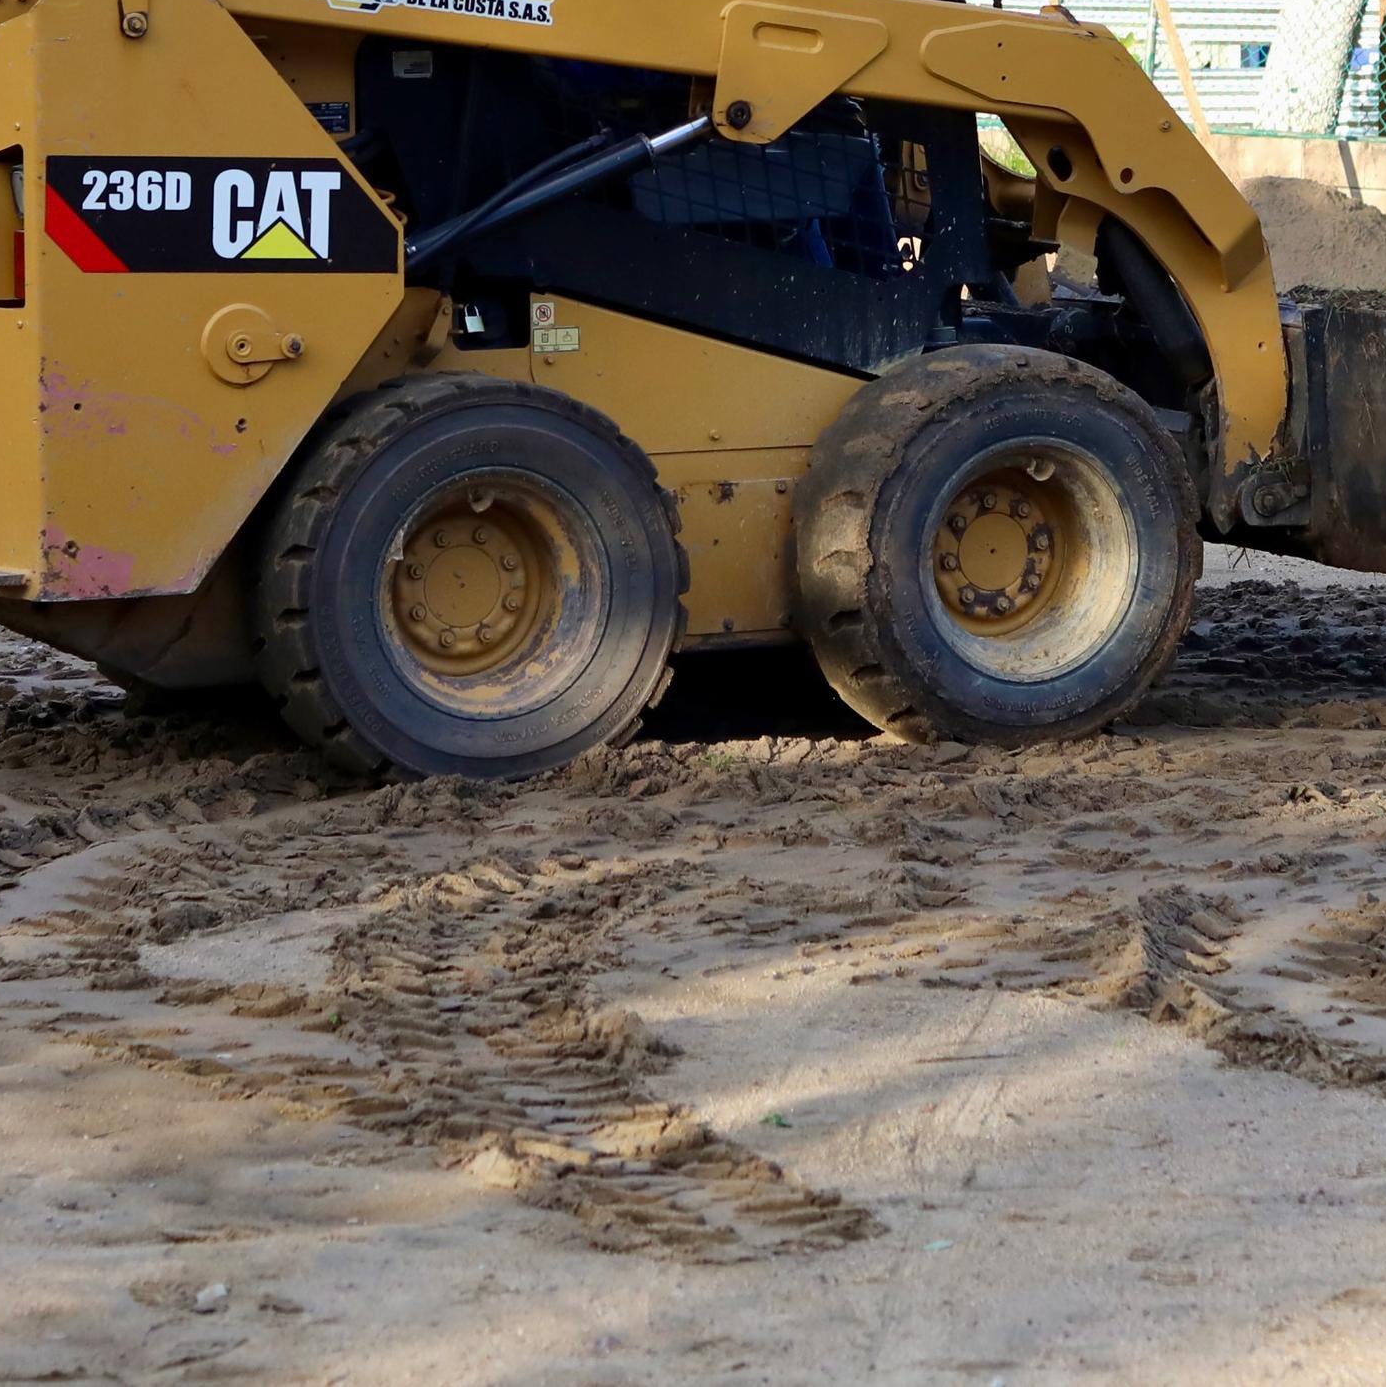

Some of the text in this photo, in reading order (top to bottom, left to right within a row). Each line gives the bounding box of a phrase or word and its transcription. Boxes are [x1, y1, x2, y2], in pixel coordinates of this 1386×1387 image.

[508, 1, 550, 23] S.A.S.
[82, 169, 341, 259] 236D CAT
